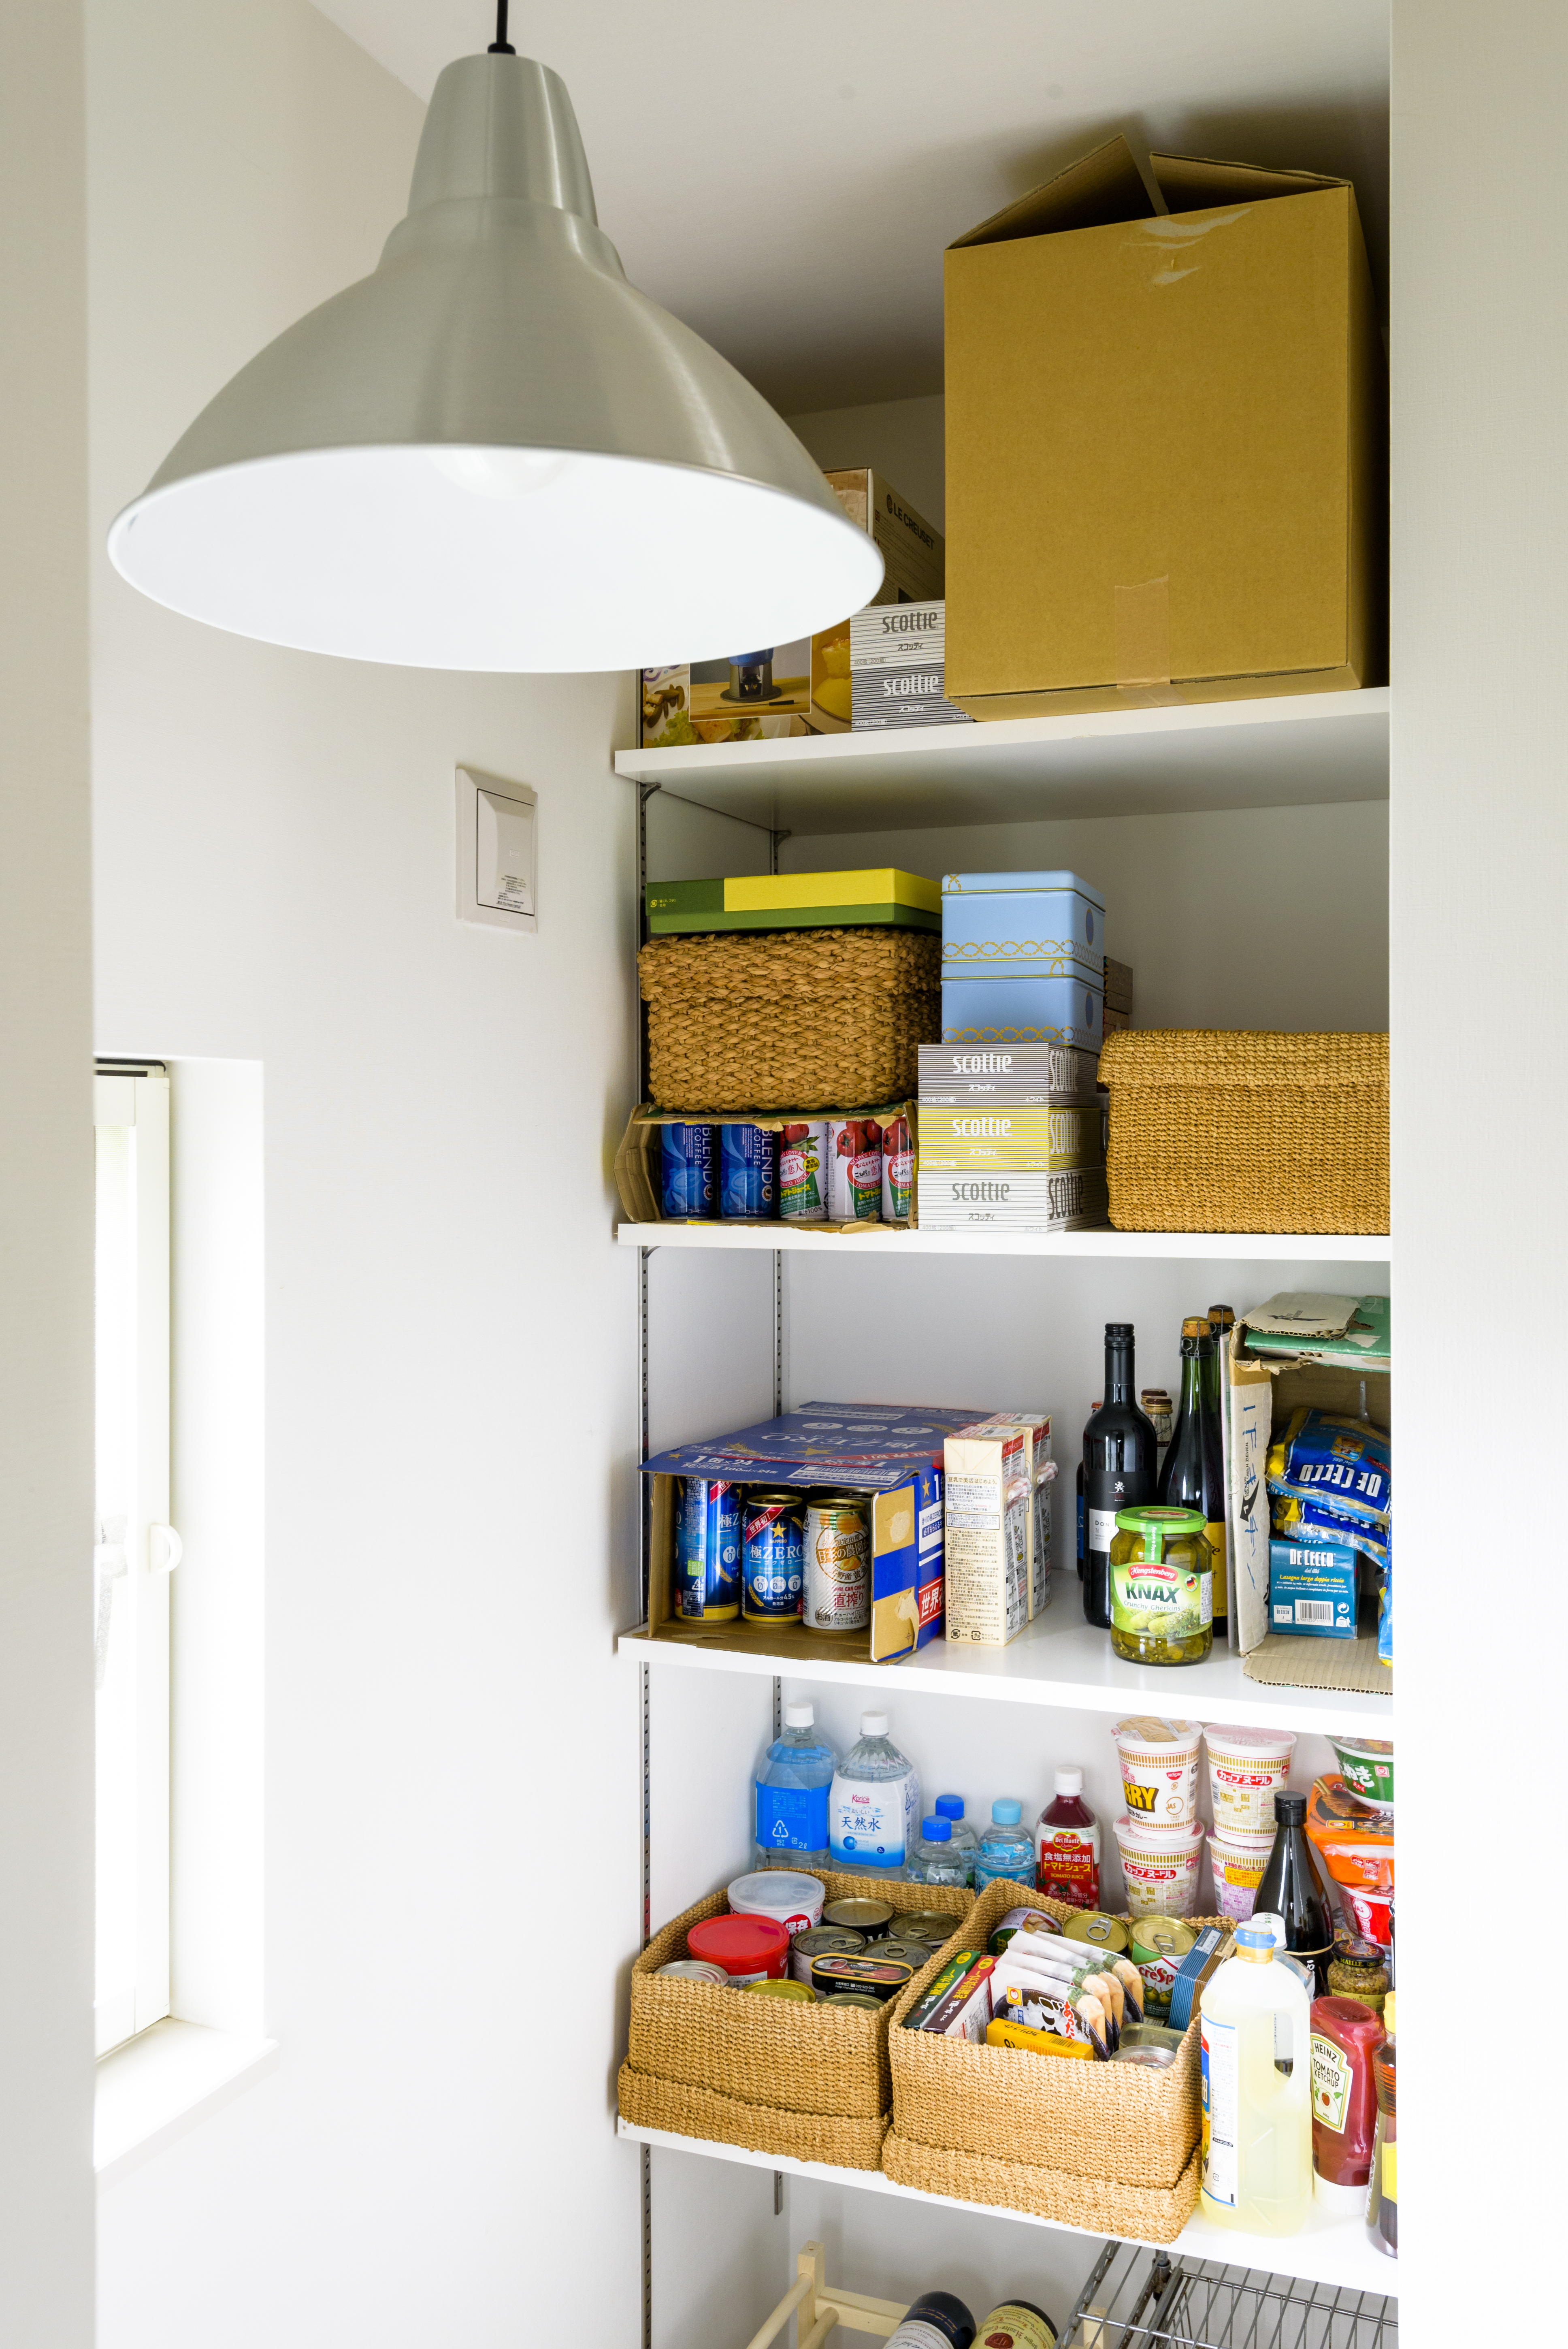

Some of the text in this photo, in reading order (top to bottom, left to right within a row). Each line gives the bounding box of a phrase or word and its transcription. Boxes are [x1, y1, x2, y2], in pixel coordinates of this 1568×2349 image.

[894, 503, 934, 550] LE CREUSET
[882, 612, 937, 633] scottie
[898, 642, 923, 651] スコッティ
[884, 675, 939, 696] scottie
[899, 705, 925, 713] スコッティ
[953, 1054, 1012, 1073] scottie
[969, 1084, 996, 1092] スコッティ
[952, 1117, 1011, 1137] scottie
[850, 1153, 868, 1165] NISPA'S
[890, 1152, 907, 1164] NISPA'S
[795, 1173, 807, 1185] JUICE
[780, 1185, 811, 1197] トマトジュース
[952, 1182, 1009, 1201] scottie
[798, 1206, 822, 1216] 果汁100%
[1299, 1464, 1382, 1497] DE CECCO
[750, 1544, 803, 1559] 極ZERO
[1290, 1549, 1334, 1567] DE CECCO
[1131, 1567, 1175, 1579] Hengstenberg
[833, 1592, 864, 1607] 直搾り
[1125, 1582, 1181, 1603] KNAX
[1124, 1600, 1148, 1611] Crunchy
[816, 1612, 830, 1621] お酒
[1219, 1771, 1270, 1785] カップヌードル
[852, 1794, 869, 1803] Kprice
[841, 1817, 882, 1832] 天然水
[1044, 1852, 1091, 1863] 食塩無添加
[1044, 1862, 1091, 1872] トマトジュース
[1126, 1864, 1174, 1878] カップヌードル
[786, 1919, 808, 1935] 保存
[958, 1954, 969, 1962] 中辛
[1340, 1958, 1363, 1967] MAILLE
[929, 1969, 955, 1995] 欧風カレー
[952, 1971, 981, 1999] 老舗洋食カレー
[1004, 2024, 1040, 2036] カロリーメイト
[1314, 2042, 1337, 2063] HEINZ
[1313, 2058, 1340, 2081] TOMATO
[1314, 2068, 1338, 2088] KETCHUP
